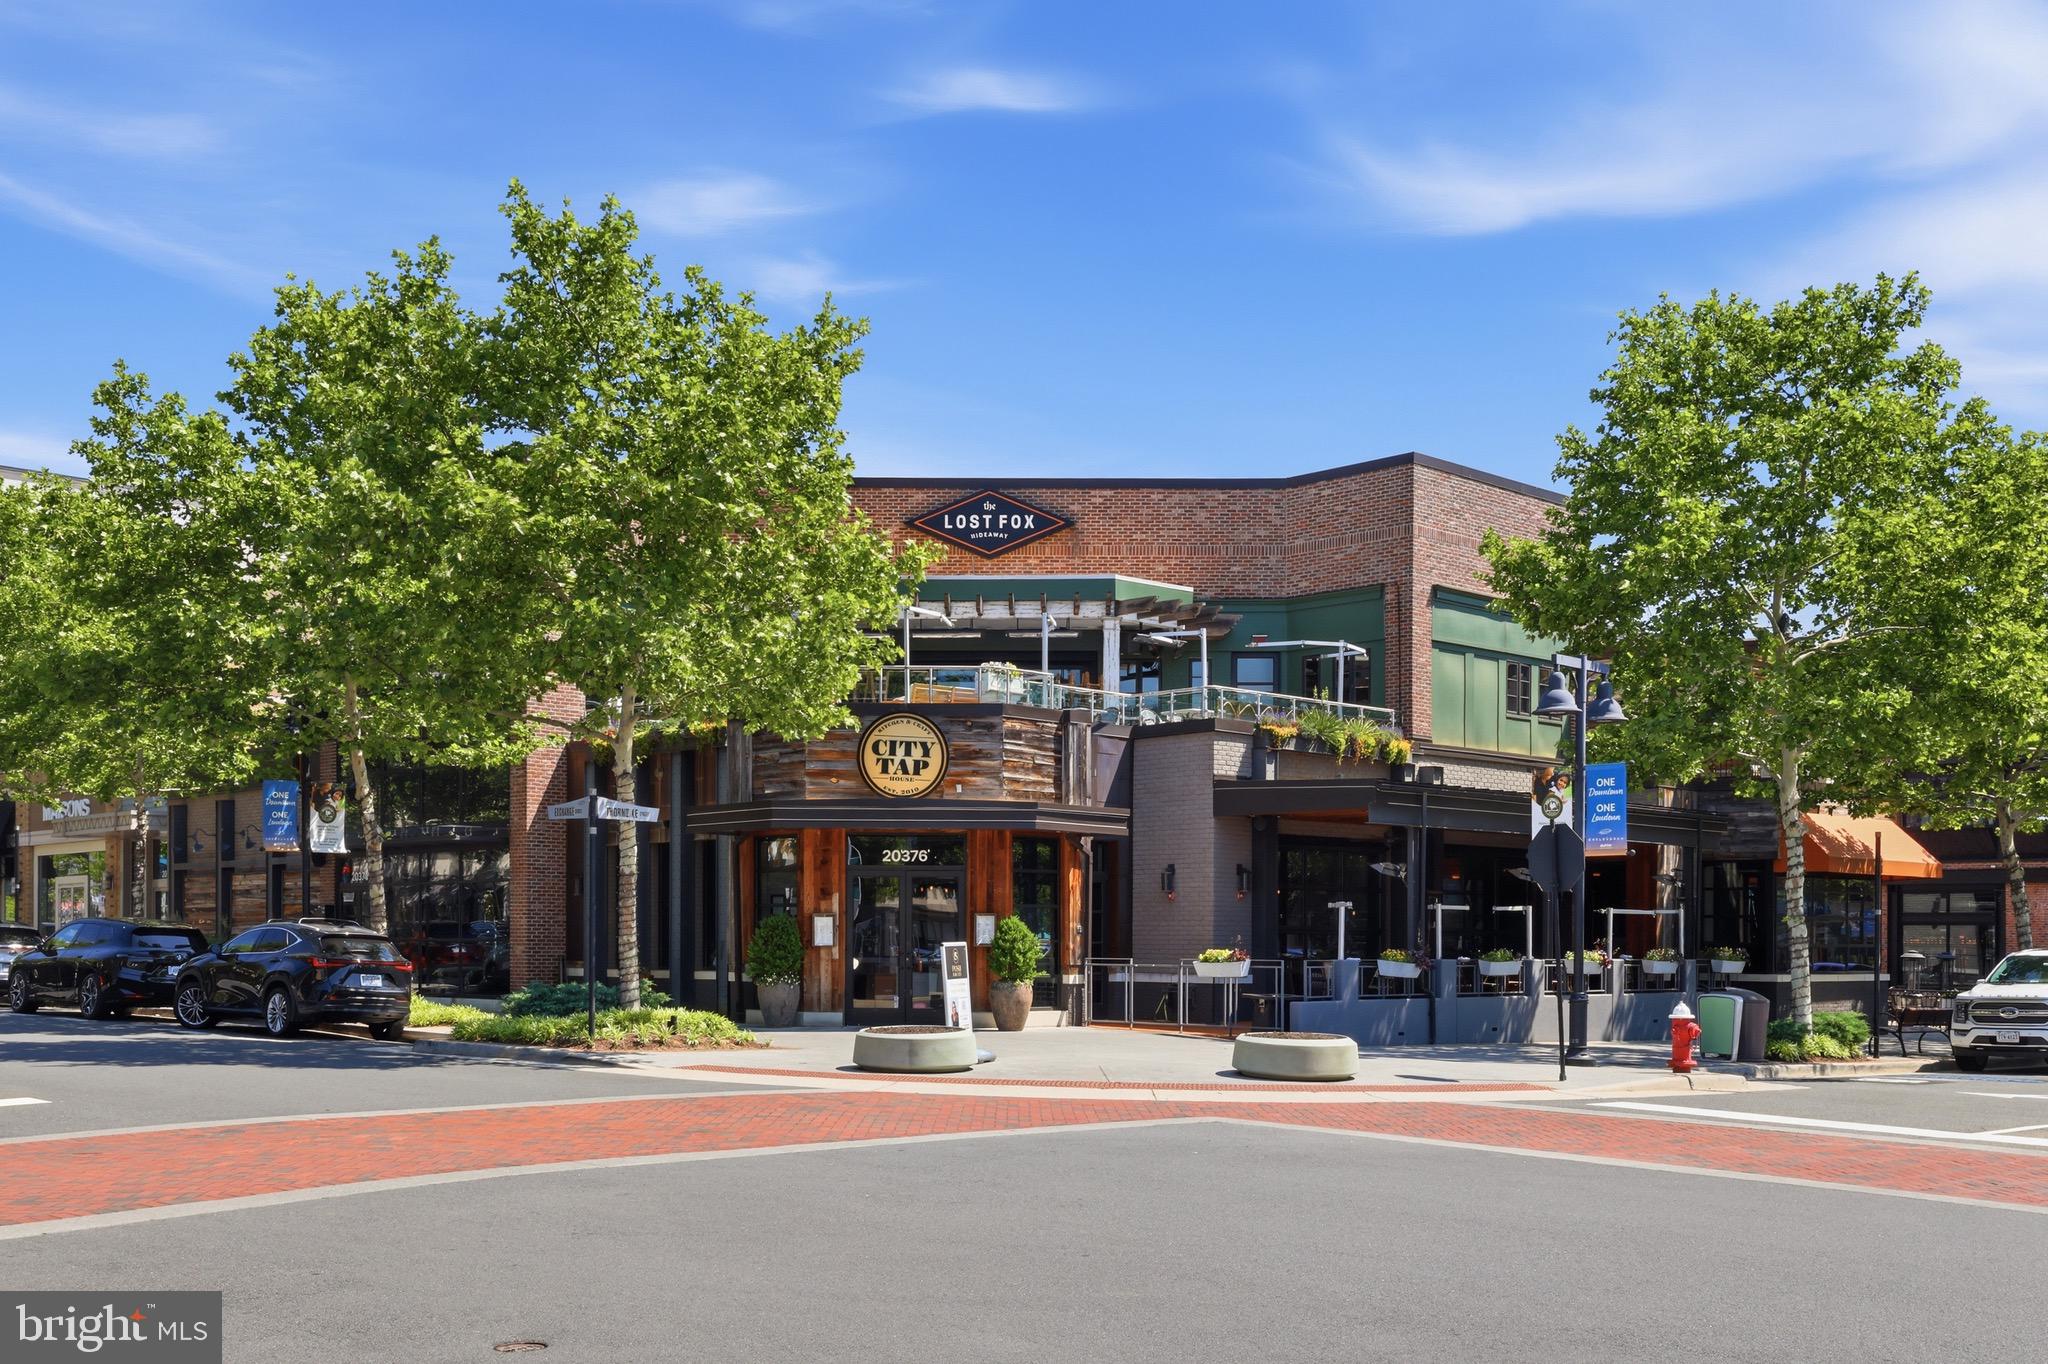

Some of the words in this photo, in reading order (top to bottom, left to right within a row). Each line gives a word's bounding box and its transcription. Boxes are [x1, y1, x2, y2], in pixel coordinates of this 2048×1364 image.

[983, 501, 996, 511] the
[944, 514, 992, 529] LOST
[998, 514, 1035, 529] FOX
[970, 532, 1009, 540] HIDEAWAY
[871, 739, 936, 758] CITY
[875, 757, 930, 776] TAP
[889, 775, 915, 783] HOUSE
[1596, 777, 1616, 787] ONE
[272, 791, 290, 799] ONE
[901, 786, 920, 795] 2010
[1588, 787, 1624, 797] Downtown
[606, 807, 638, 819] THORNDKE
[1596, 803, 1616, 813] ONE
[271, 811, 289, 819] ONE
[1591, 812, 1621, 823] Loudoun
[882, 849, 929, 862] 20376
